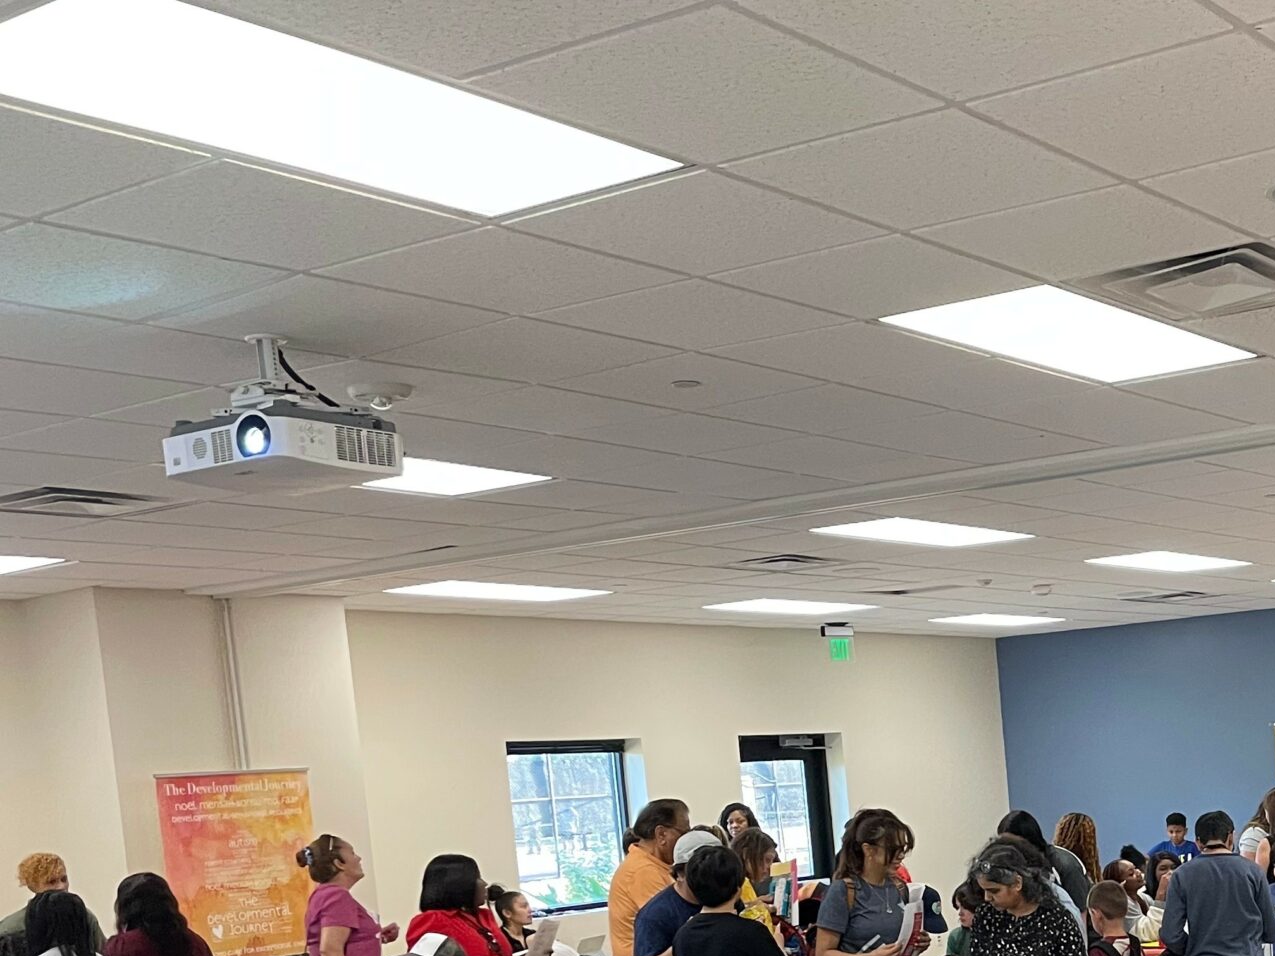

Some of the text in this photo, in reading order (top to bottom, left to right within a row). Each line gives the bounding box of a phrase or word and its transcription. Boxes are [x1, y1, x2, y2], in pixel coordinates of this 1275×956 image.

[164, 778, 301, 796] The Developmental Journey
